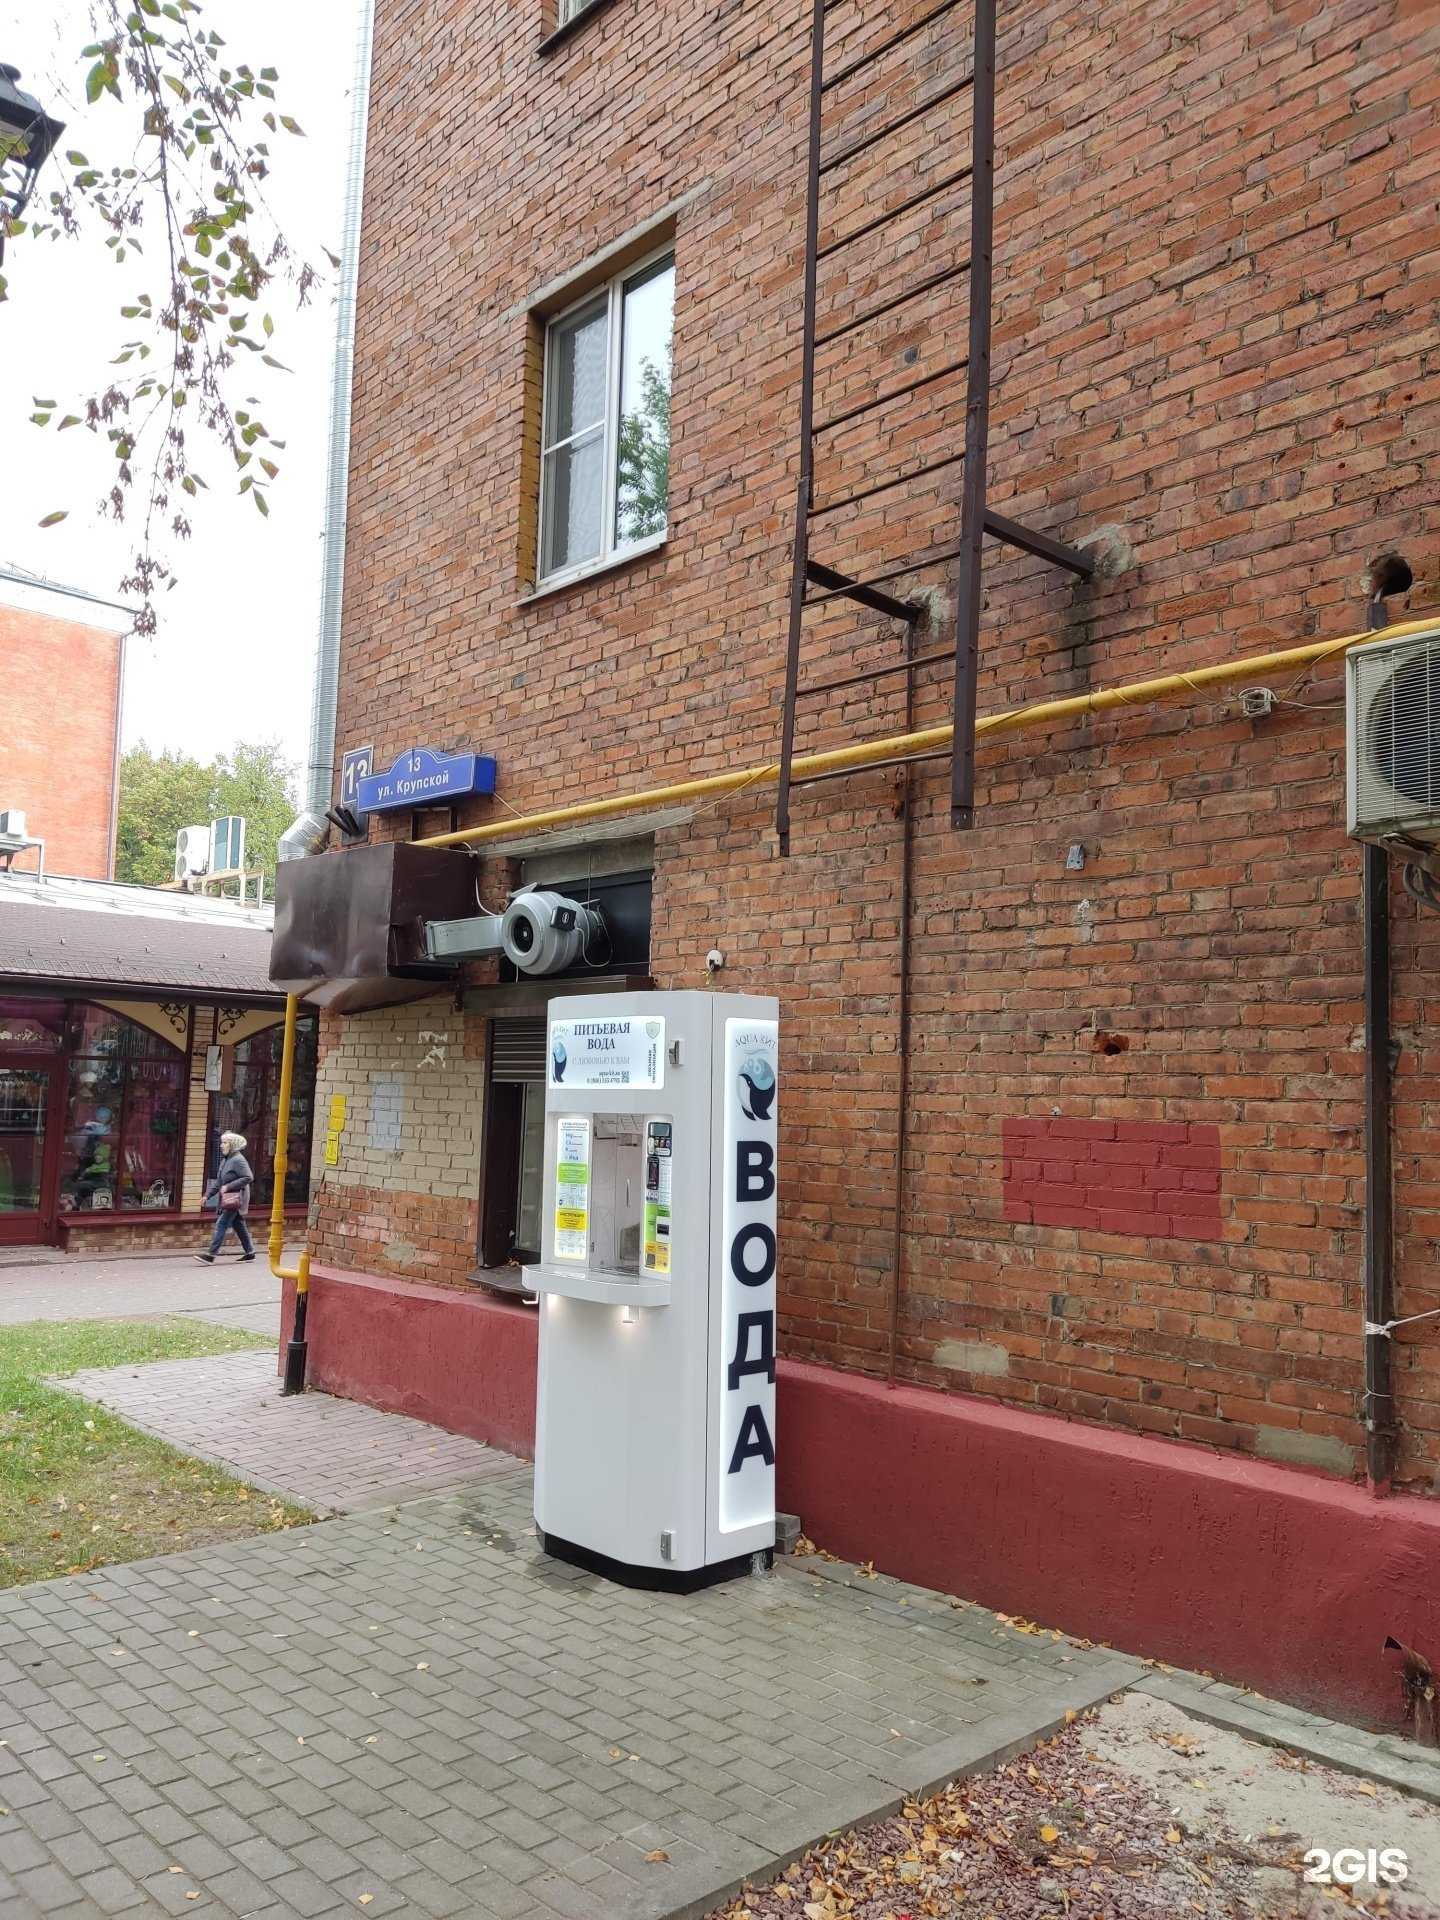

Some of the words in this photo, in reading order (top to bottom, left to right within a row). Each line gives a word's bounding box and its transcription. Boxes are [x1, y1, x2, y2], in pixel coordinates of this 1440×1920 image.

[408, 756, 421, 773] 13
[378, 785, 394, 801] ул.
[397, 770, 449, 797] Крупской
[574, 1022, 630, 1036] ПИТЬЕВАЯ
[587, 1038, 616, 1051] ВОДА
[728, 1140, 776, 1475] ВОДА
